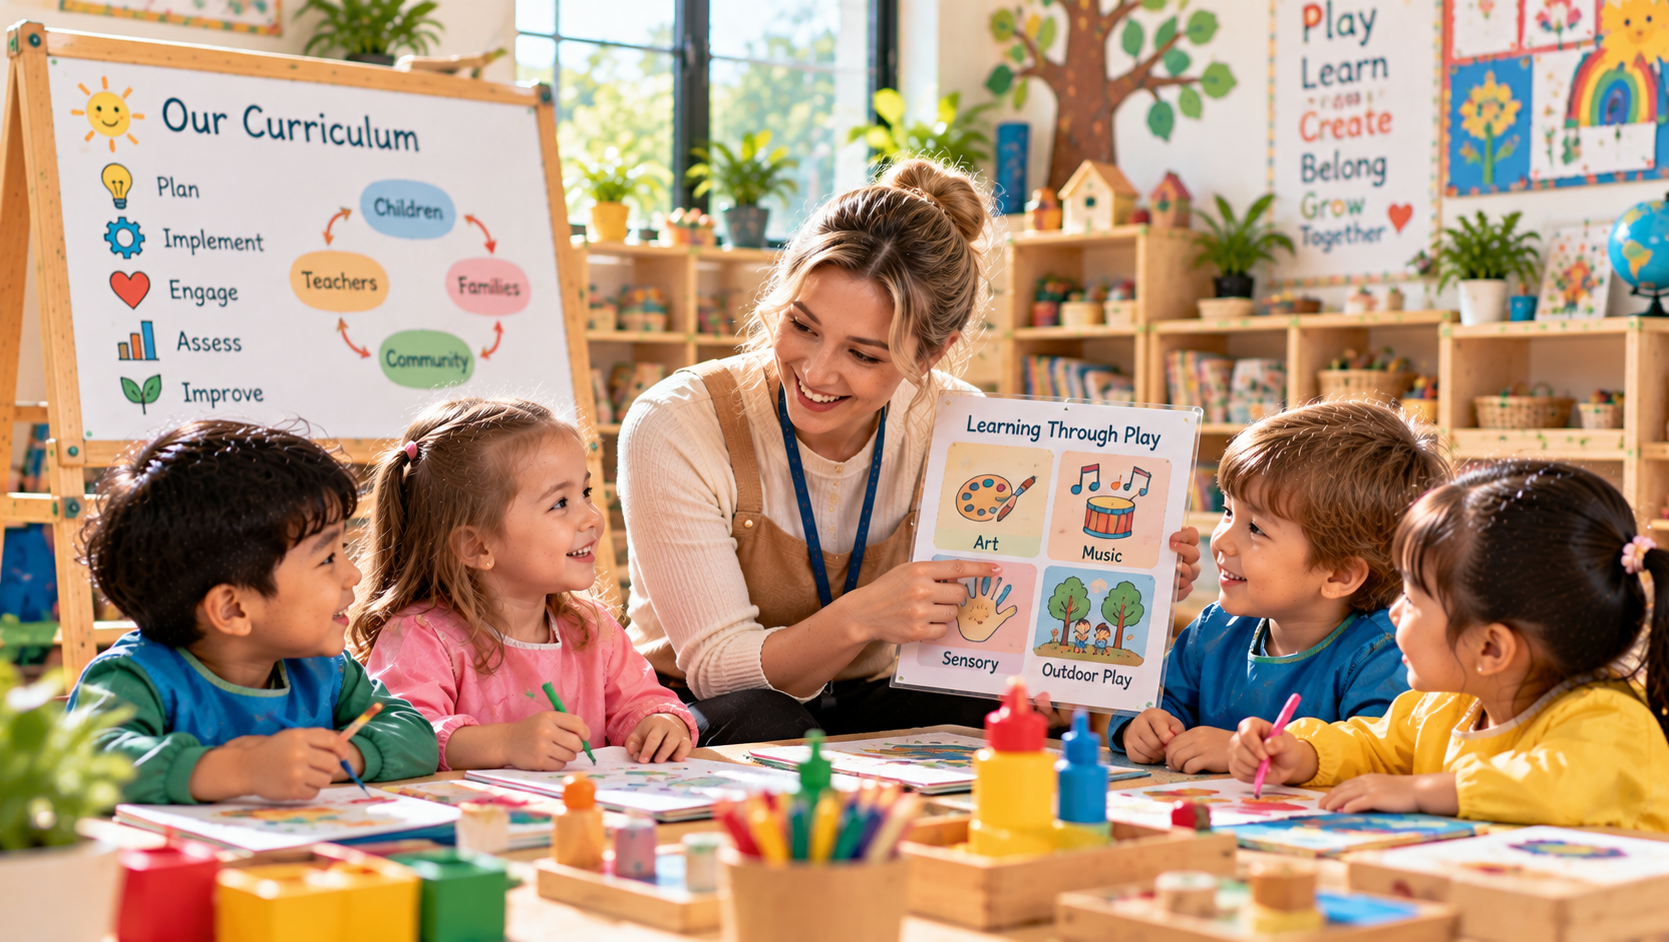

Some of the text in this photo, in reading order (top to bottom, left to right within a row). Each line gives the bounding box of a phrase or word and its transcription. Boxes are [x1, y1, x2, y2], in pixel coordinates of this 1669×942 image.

[1302, 0, 1376, 47] Play
[1302, 57, 1388, 90] Learn
[162, 97, 419, 151] Our Curriculum
[1299, 109, 1392, 143] Create
[1301, 150, 1387, 187] Belong
[157, 176, 199, 198] Plan
[374, 197, 443, 220] Children
[1300, 192, 1365, 221] Grow
[163, 228, 264, 255] Implement
[1299, 222, 1387, 253] Together
[169, 279, 238, 307] Engage
[301, 271, 377, 291] Teachers
[458, 276, 520, 296] Families
[177, 331, 242, 352] Assess
[385, 348, 470, 374] Community
[182, 382, 263, 409] Improve
[967, 415, 1161, 451] Learning Through Play
[973, 535, 999, 551] Art
[1082, 545, 1122, 562] Music
[942, 651, 999, 674] Sensory
[1042, 662, 1132, 690] Outdoor Play
